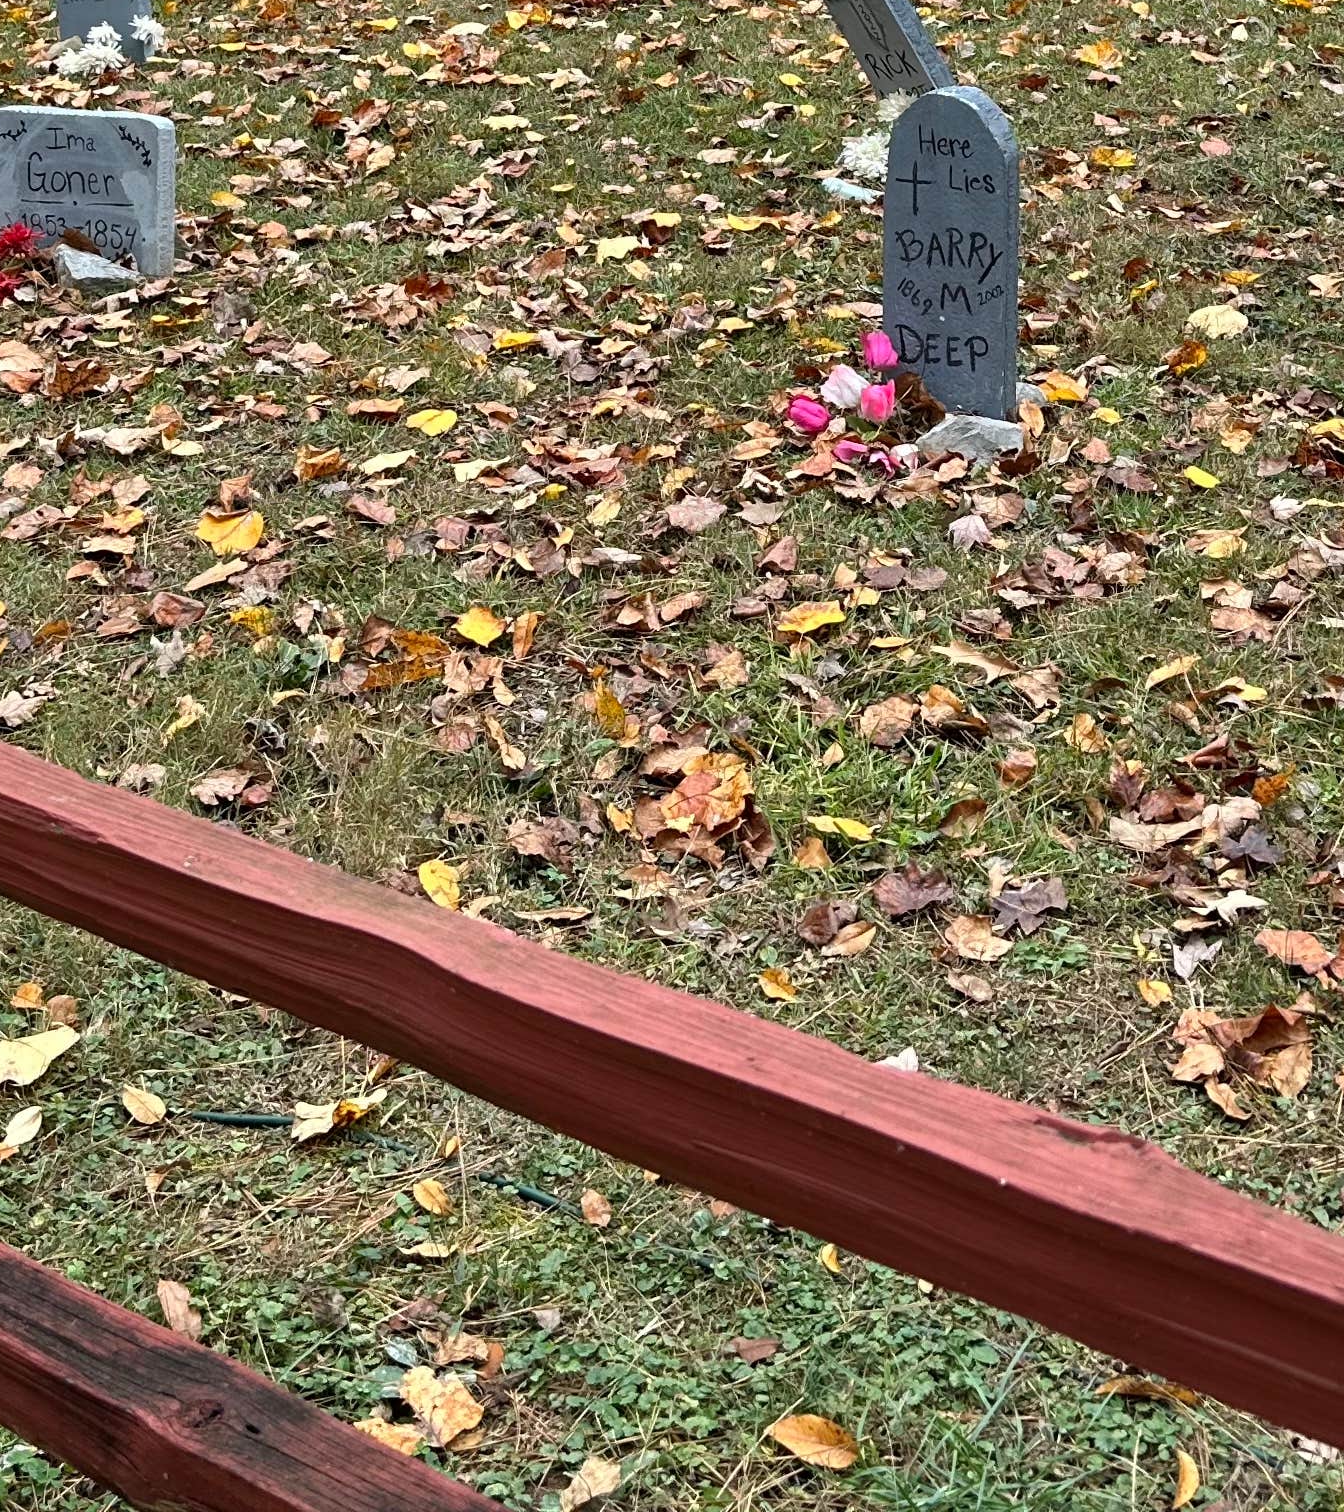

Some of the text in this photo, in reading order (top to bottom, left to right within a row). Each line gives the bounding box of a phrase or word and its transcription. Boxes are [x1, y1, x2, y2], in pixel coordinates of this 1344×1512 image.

[865, 50, 919, 81] RICK
[46, 127, 97, 152] Ima
[918, 124, 975, 158] Here
[27, 152, 115, 197] Goner
[949, 165, 996, 194] Lies
[897, 277, 1005, 316] 1869 M 2002
[894, 324, 989, 373] DEEP
